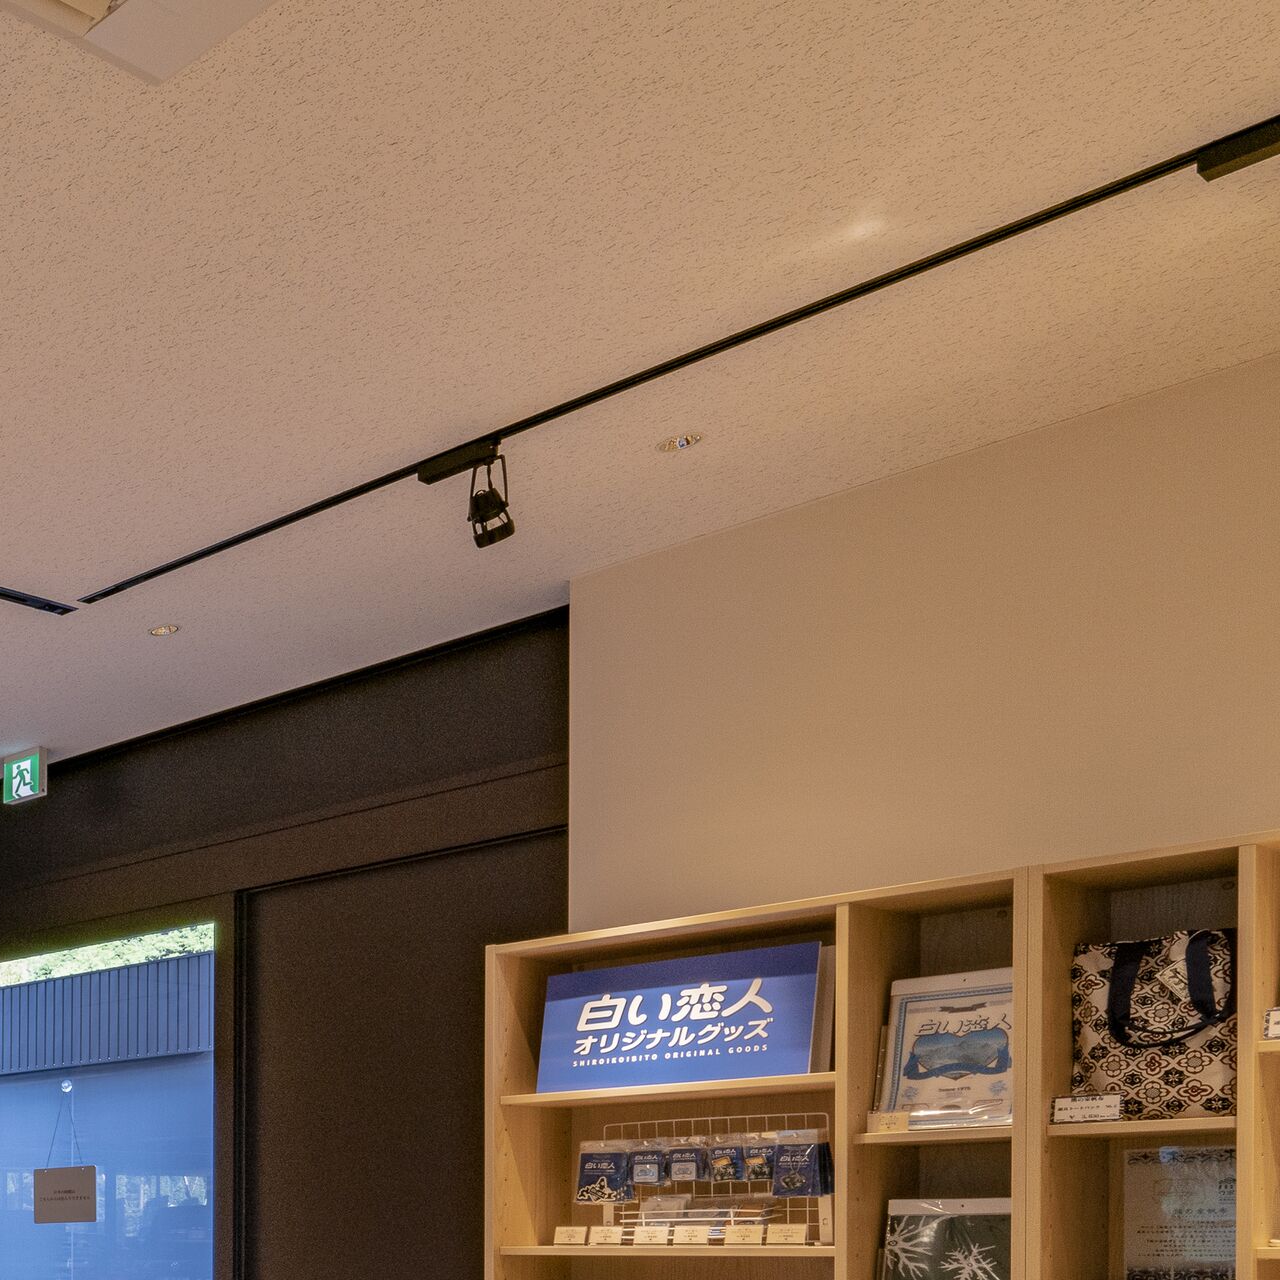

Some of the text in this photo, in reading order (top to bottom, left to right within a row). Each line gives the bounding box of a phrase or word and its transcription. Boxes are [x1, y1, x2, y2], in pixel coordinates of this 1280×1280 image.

[576, 978, 773, 1032] 白い恋人
[572, 1044, 768, 1067] SHIROIKOIBITO ORIGINAL GOODS
[573, 1018, 774, 1056] オリジナルグッズ
